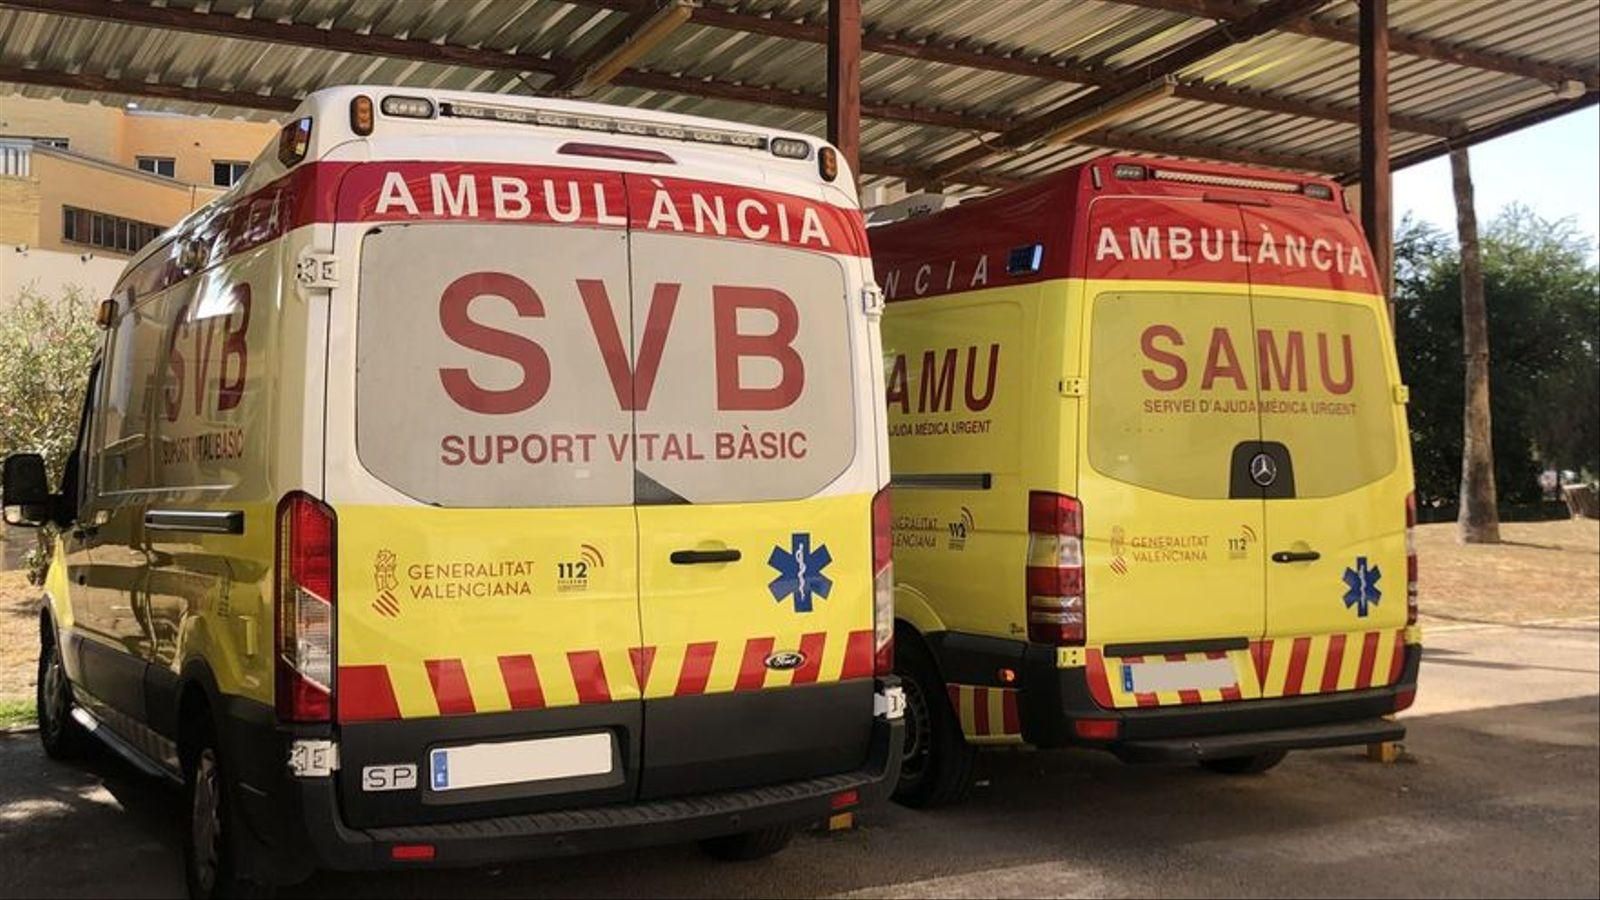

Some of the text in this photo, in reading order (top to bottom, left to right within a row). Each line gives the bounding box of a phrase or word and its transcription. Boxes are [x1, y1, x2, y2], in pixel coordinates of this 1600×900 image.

[375, 171, 832, 248] AMBULÀNCIA
[1095, 223, 1368, 279] AMBULÀNCIA
[165, 282, 252, 423] SVB
[439, 270, 806, 416] SVB
[1140, 324, 1356, 396] SAMU
[1143, 399, 1195, 413] SERVEI
[1199, 399, 1256, 414] D'AJUDA
[1311, 401, 1357, 416] URGENT
[952, 419, 992, 435] URGENT
[440, 424, 808, 467] SUPORT VITAL BÀSIC
[1131, 535, 1209, 549] GENERALITAT
[1228, 537, 1247, 551] 112
[1132, 549, 1208, 563] VALENCIANA
[407, 560, 535, 581] GENERALITAT
[557, 562, 588, 579] 112
[410, 581, 532, 600] VALENCIANA
